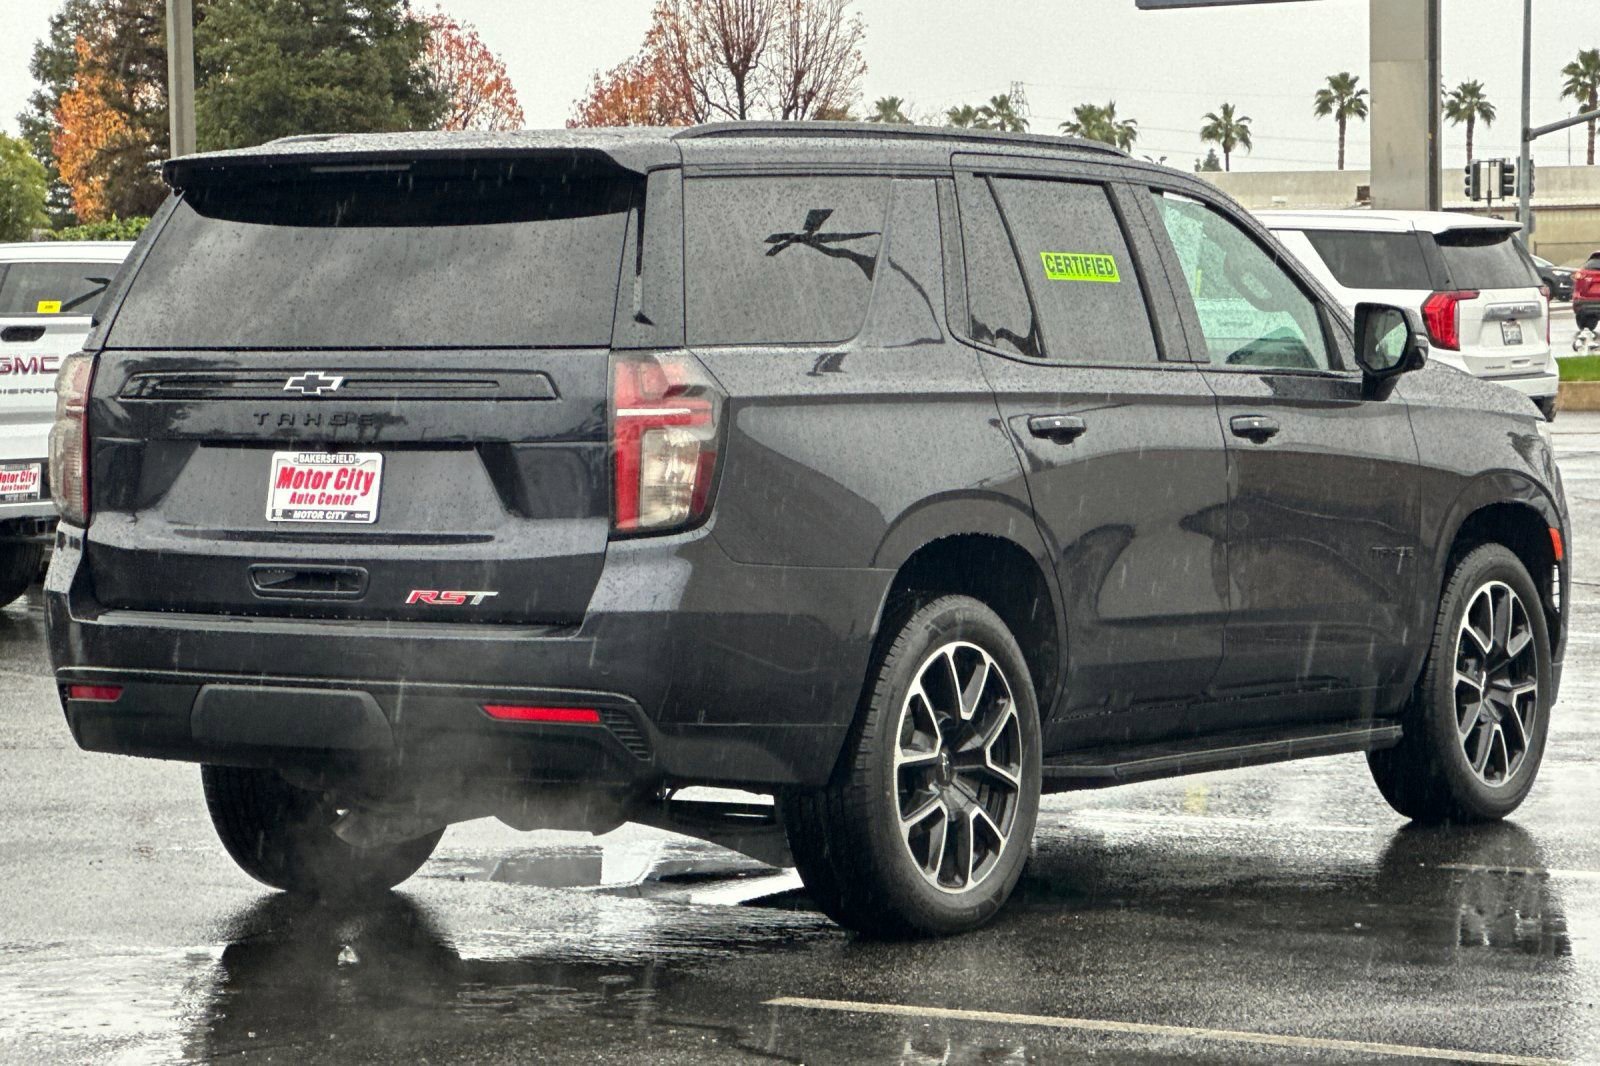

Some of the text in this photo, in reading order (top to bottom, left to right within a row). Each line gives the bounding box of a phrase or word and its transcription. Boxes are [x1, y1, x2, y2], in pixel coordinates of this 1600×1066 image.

[1044, 255, 1115, 275] CERTIFIED
[0, 356, 59, 374] GMC
[253, 412, 374, 426] TAHOE
[299, 454, 355, 464] BAKERSFIELD
[20, 471, 38, 485] City
[276, 466, 375, 496] Motor City
[289, 491, 357, 506] Auto Center
[293, 510, 325, 519] MOTOR
[325, 511, 347, 519] CITY
[405, 590, 499, 605] RST
